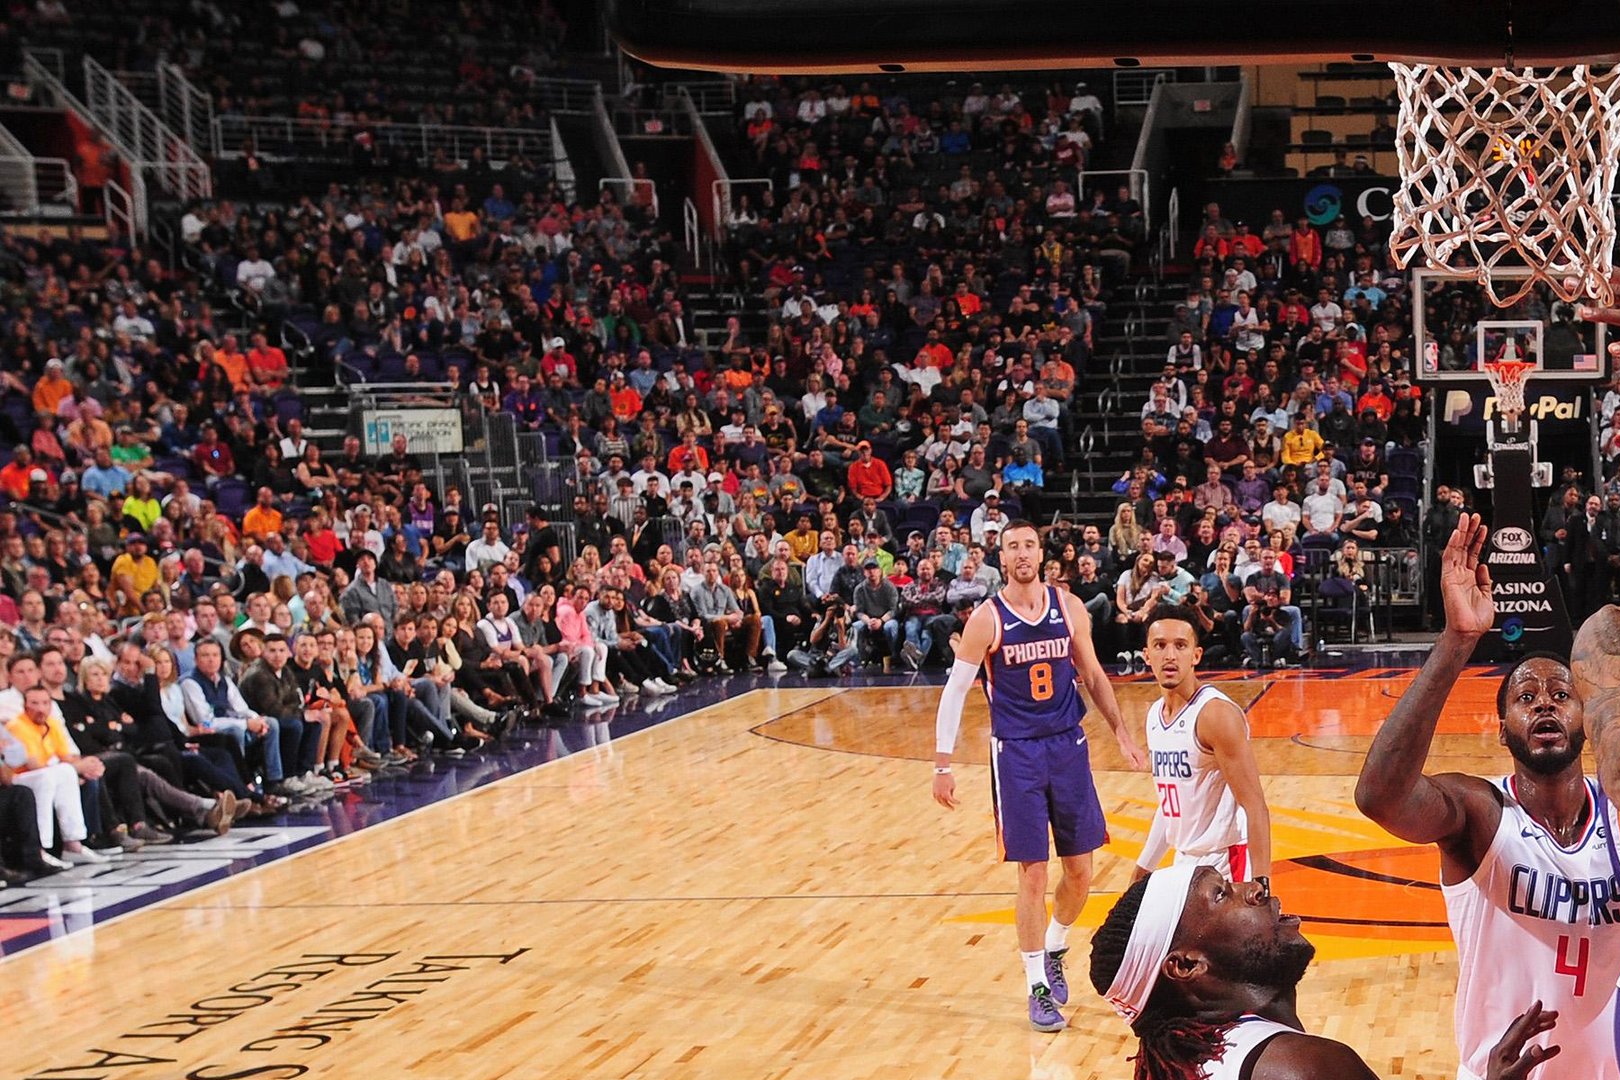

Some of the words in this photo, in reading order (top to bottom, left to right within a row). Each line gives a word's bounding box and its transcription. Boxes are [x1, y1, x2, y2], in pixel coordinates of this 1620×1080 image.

[1483, 395, 1582, 420] PPal
[1501, 532, 1523, 542] FOX
[1488, 552, 1556, 564] ARIZONA
[1491, 581, 1545, 595] ASINO
[1492, 600, 1553, 613] RIZONA
[1002, 636, 1071, 666] PHOENIX
[1029, 662, 1054, 701] 8
[1149, 749, 1192, 778] LIPPERS
[1157, 783, 1181, 818] 20
[1555, 935, 1590, 997] 4
[119, 950, 401, 1043] RESORT
[240, 947, 532, 1052] TALKING
